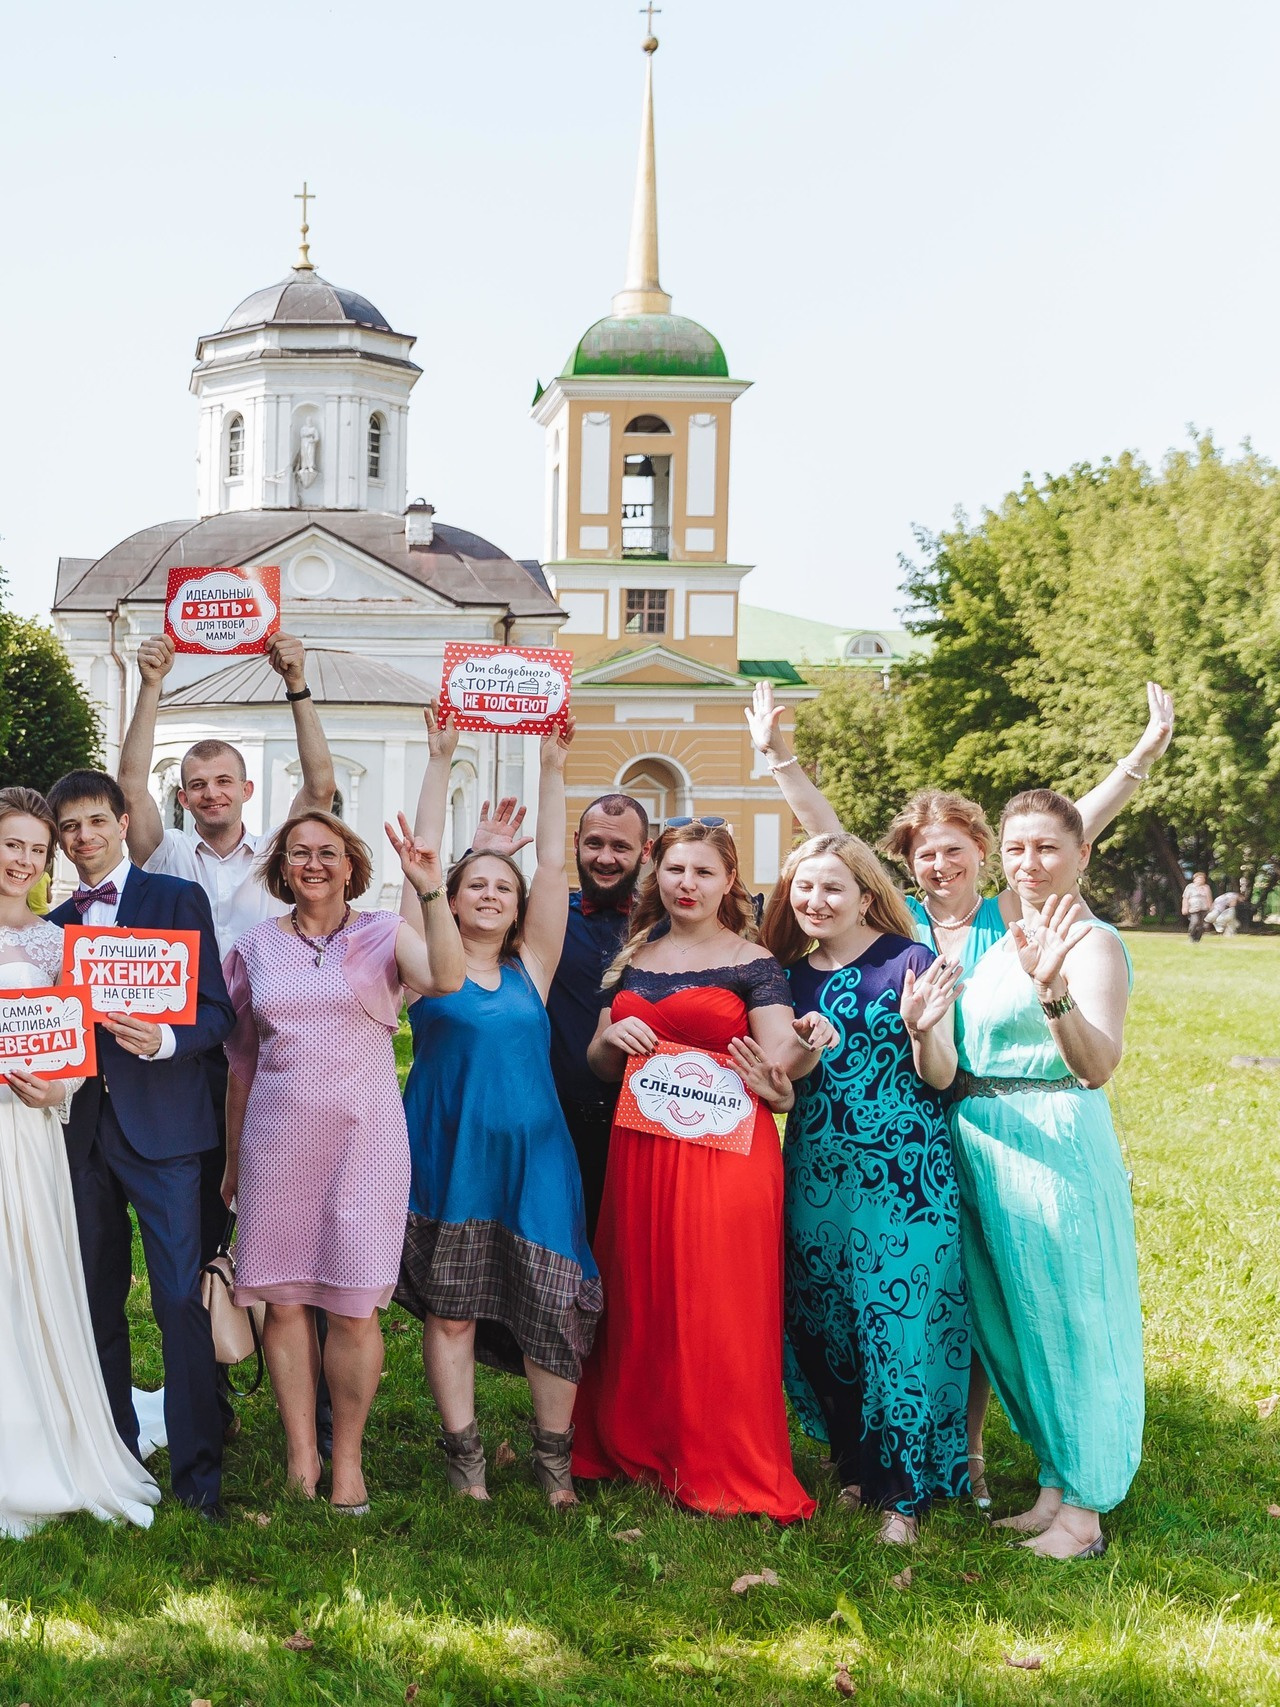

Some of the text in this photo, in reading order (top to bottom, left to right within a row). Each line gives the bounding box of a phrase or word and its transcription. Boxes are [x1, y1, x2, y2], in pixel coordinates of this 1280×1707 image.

[186, 585, 254, 602] ИДЕАЛЬНЫЙ
[197, 602, 243, 617] ЗЯТЬ
[196, 618, 245, 631] ДЛЯ ТВОЕЙ
[206, 631, 236, 641] МАМЫ
[465, 662, 551, 679] От свадебного
[466, 677, 514, 693] ТОРТА
[464, 694, 547, 713] НЕ ТОЛСТЕЮТ
[99, 944, 157, 958] ЛУЧШИЙ
[88, 962, 177, 985] ЖЕНИХ
[103, 988, 155, 999] НА СВЕТЕ
[2, 1004, 42, 1019] САМАЯ
[640, 1078, 742, 1111] СЛЕДУЮЩАЯ!
